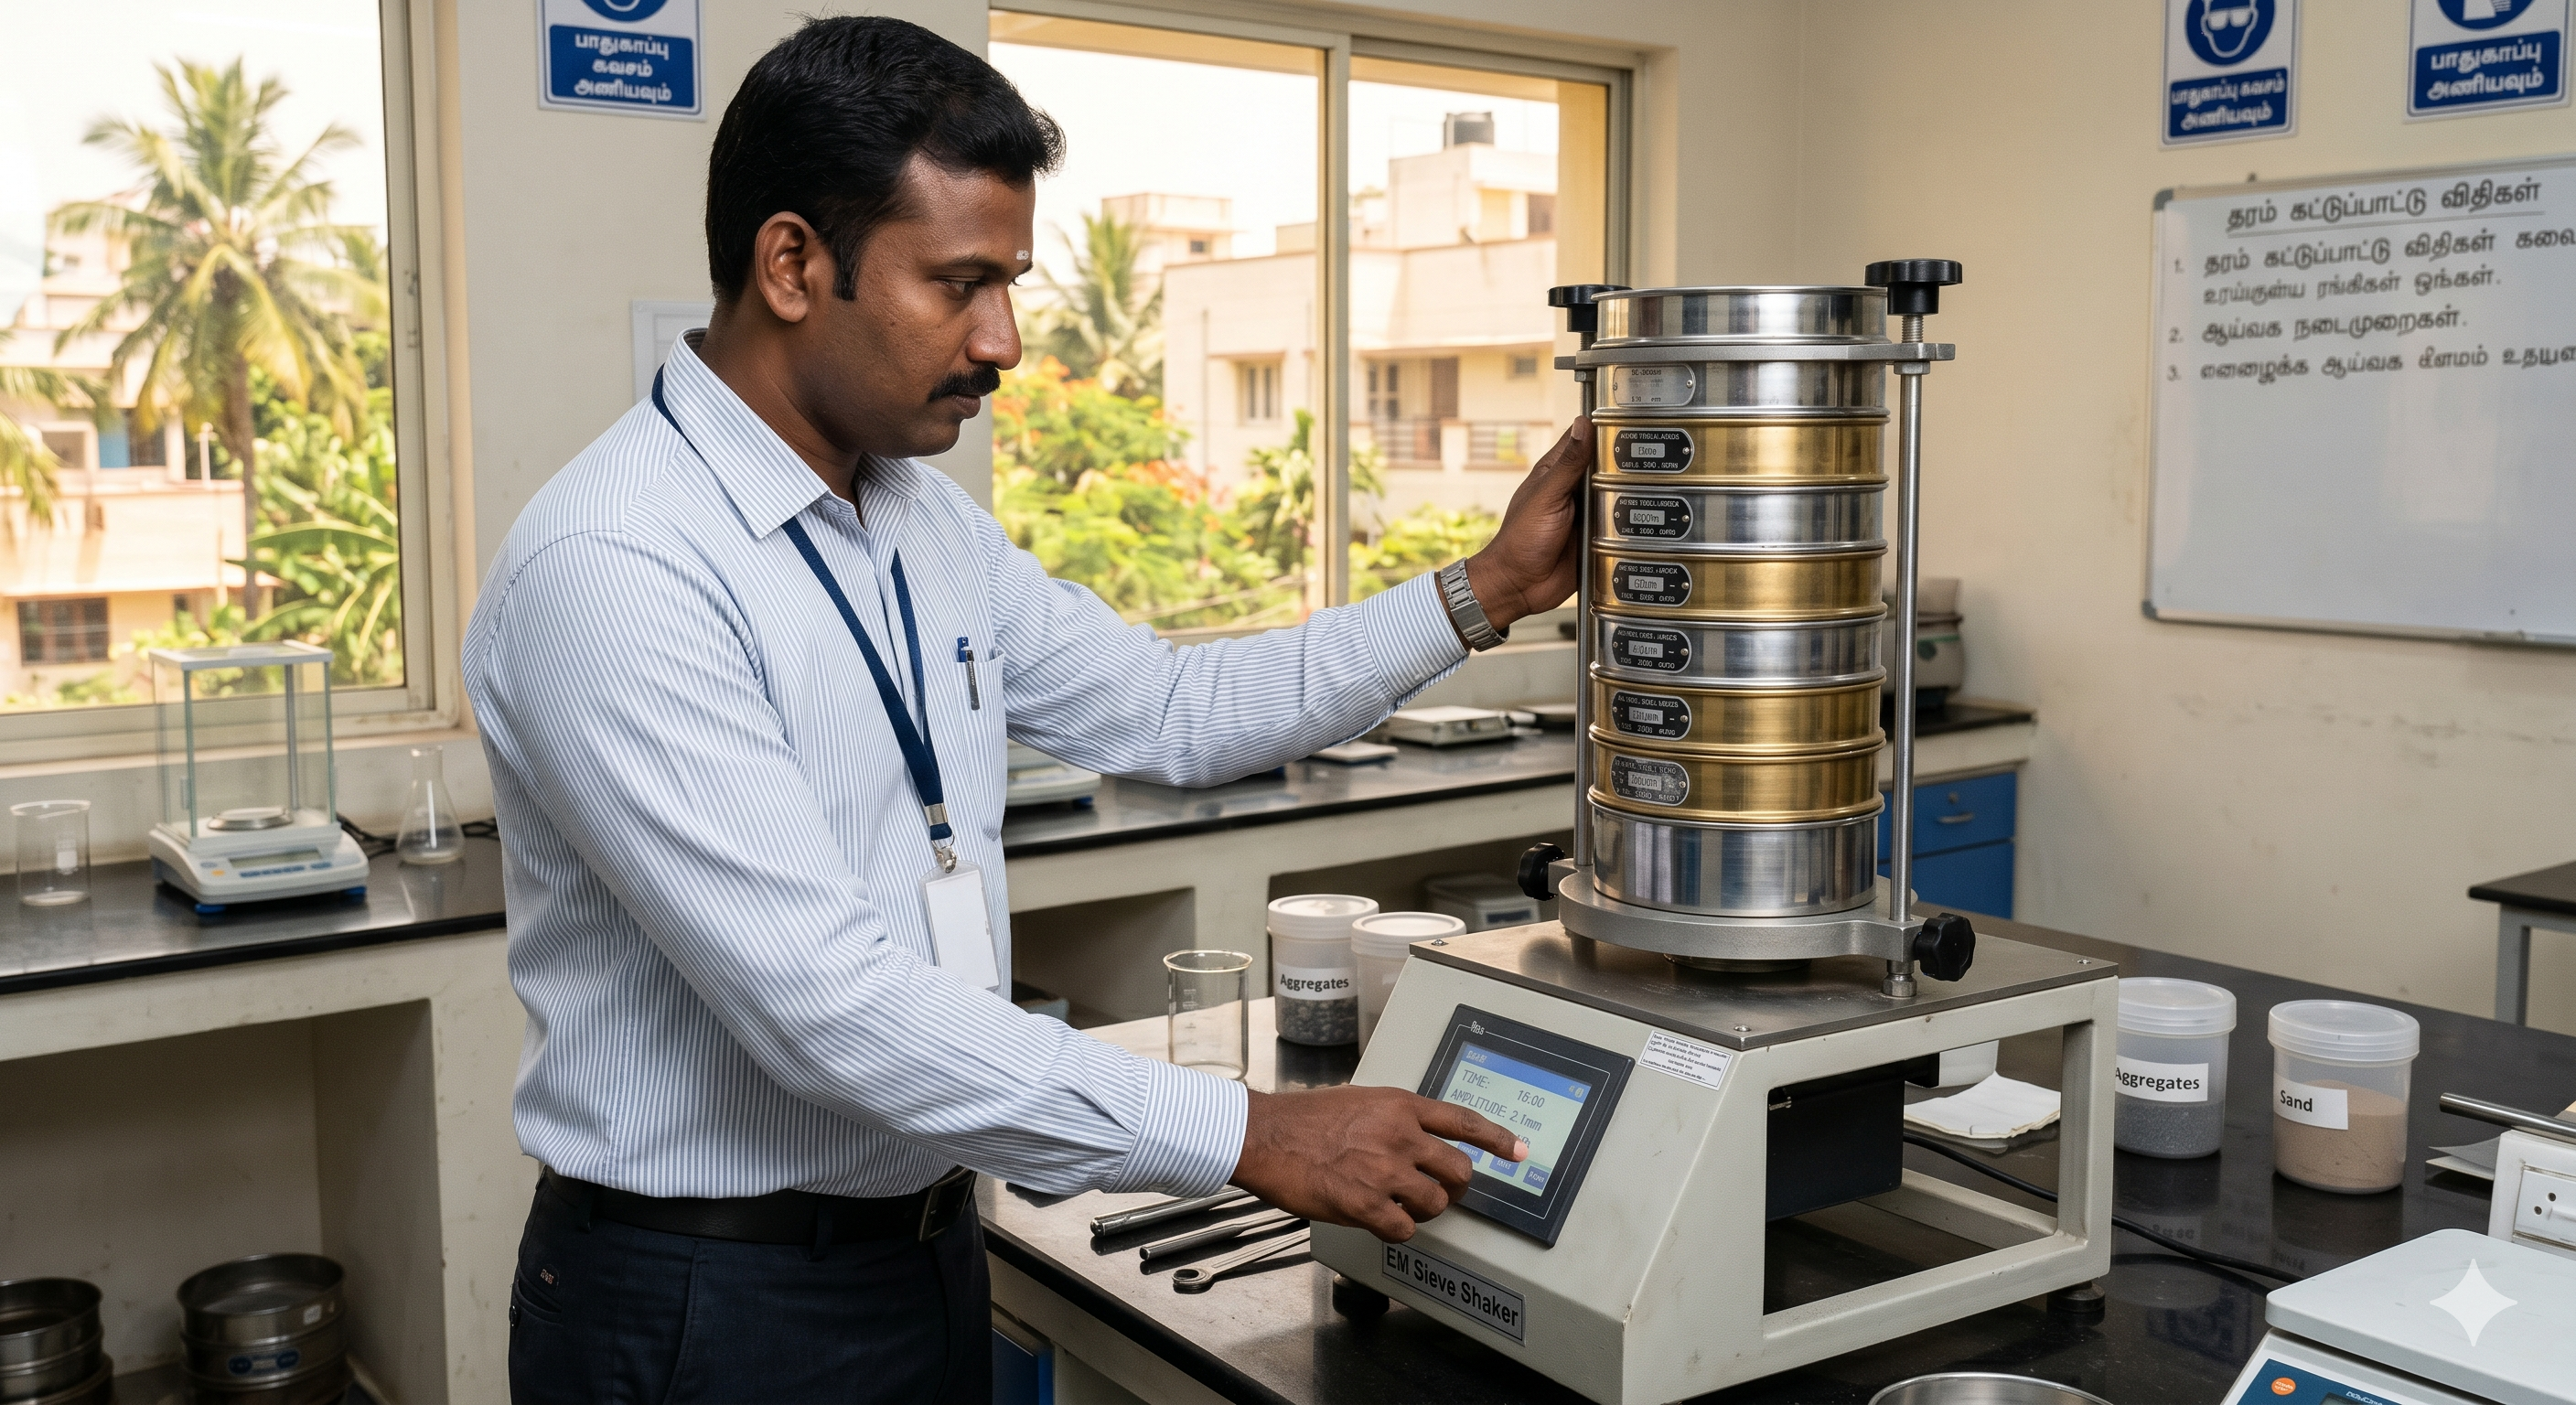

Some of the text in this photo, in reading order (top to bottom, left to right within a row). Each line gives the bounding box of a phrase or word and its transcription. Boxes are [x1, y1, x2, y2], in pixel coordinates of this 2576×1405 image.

[574, 33, 670, 60] பாதுகாப்பு
[2430, 38, 2542, 73] பாதுகாப்பு
[592, 59, 653, 77] கவசம்
[574, 78, 672, 104] அணியவும்
[2427, 66, 2545, 101] அணியவும்
[2180, 100, 2273, 131] அணியவும்
[2225, 176, 2542, 233] தரம் கட்டுப்பாட்டு விதிகள்
[2203, 246, 2250, 279] தரம்
[2263, 236, 2390, 271] கட்டுப்பாட்டு
[2404, 227, 2496, 263] விதிகள்
[1280, 973, 1349, 992] Aggregates
[2115, 1067, 2200, 1092] Aggregates
[2280, 1089, 2313, 1113] Sand
[1387, 1245, 1519, 1326] EM Sieve Shaker
